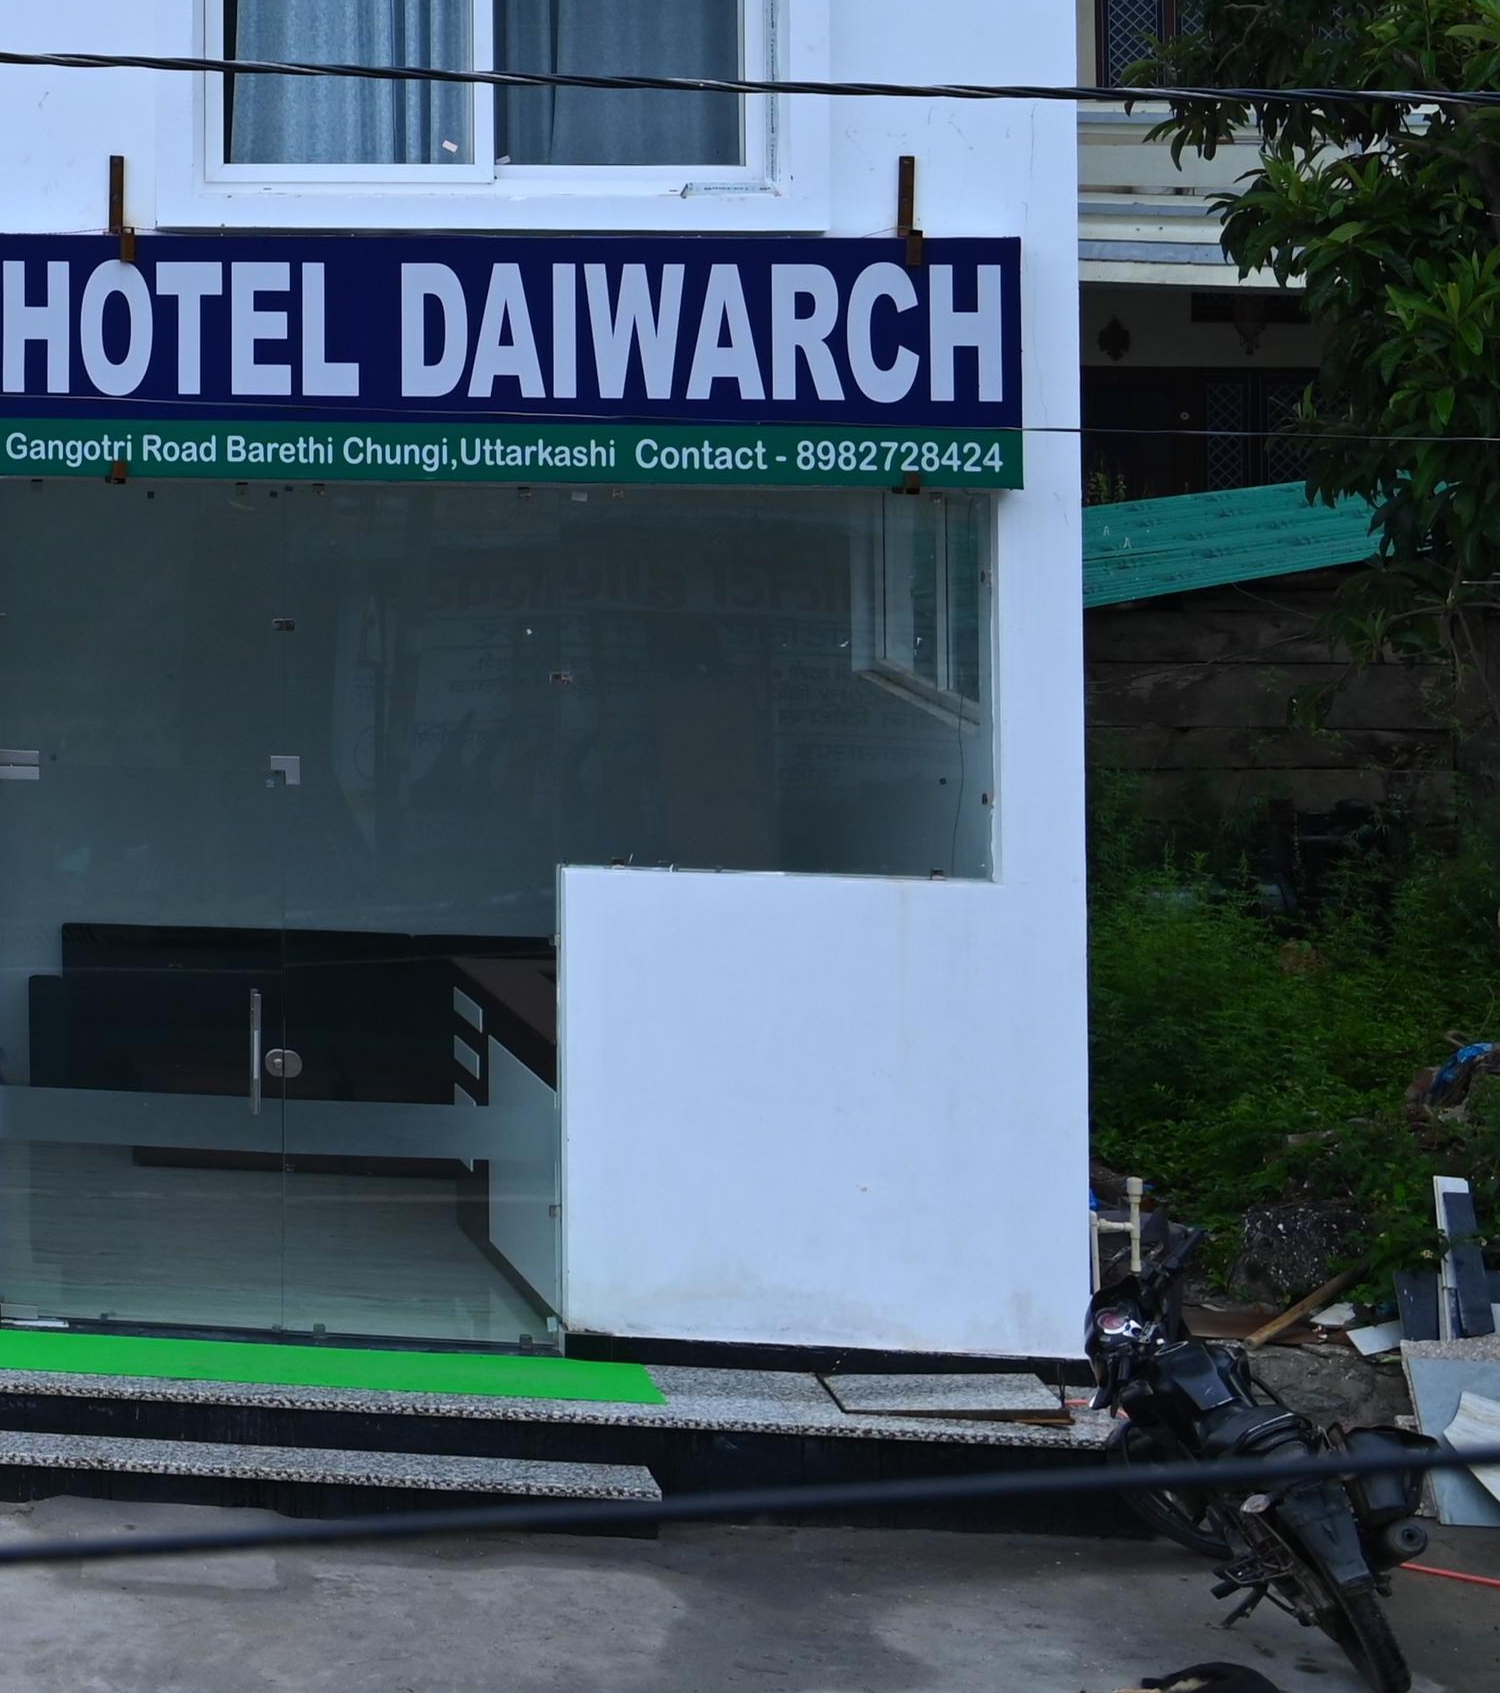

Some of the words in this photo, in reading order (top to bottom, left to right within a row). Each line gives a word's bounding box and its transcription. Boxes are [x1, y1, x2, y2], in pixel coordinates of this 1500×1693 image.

[2, 260, 359, 398] HOTEL
[401, 262, 1003, 403] DAIWARCH
[6, 432, 132, 468] Gangotri
[142, 434, 217, 462] Road
[227, 435, 333, 464] Barethi
[343, 436, 616, 472] Chungi,Uttarkashi
[635, 438, 768, 470] Contact
[796, 440, 1003, 473] 8982728424
